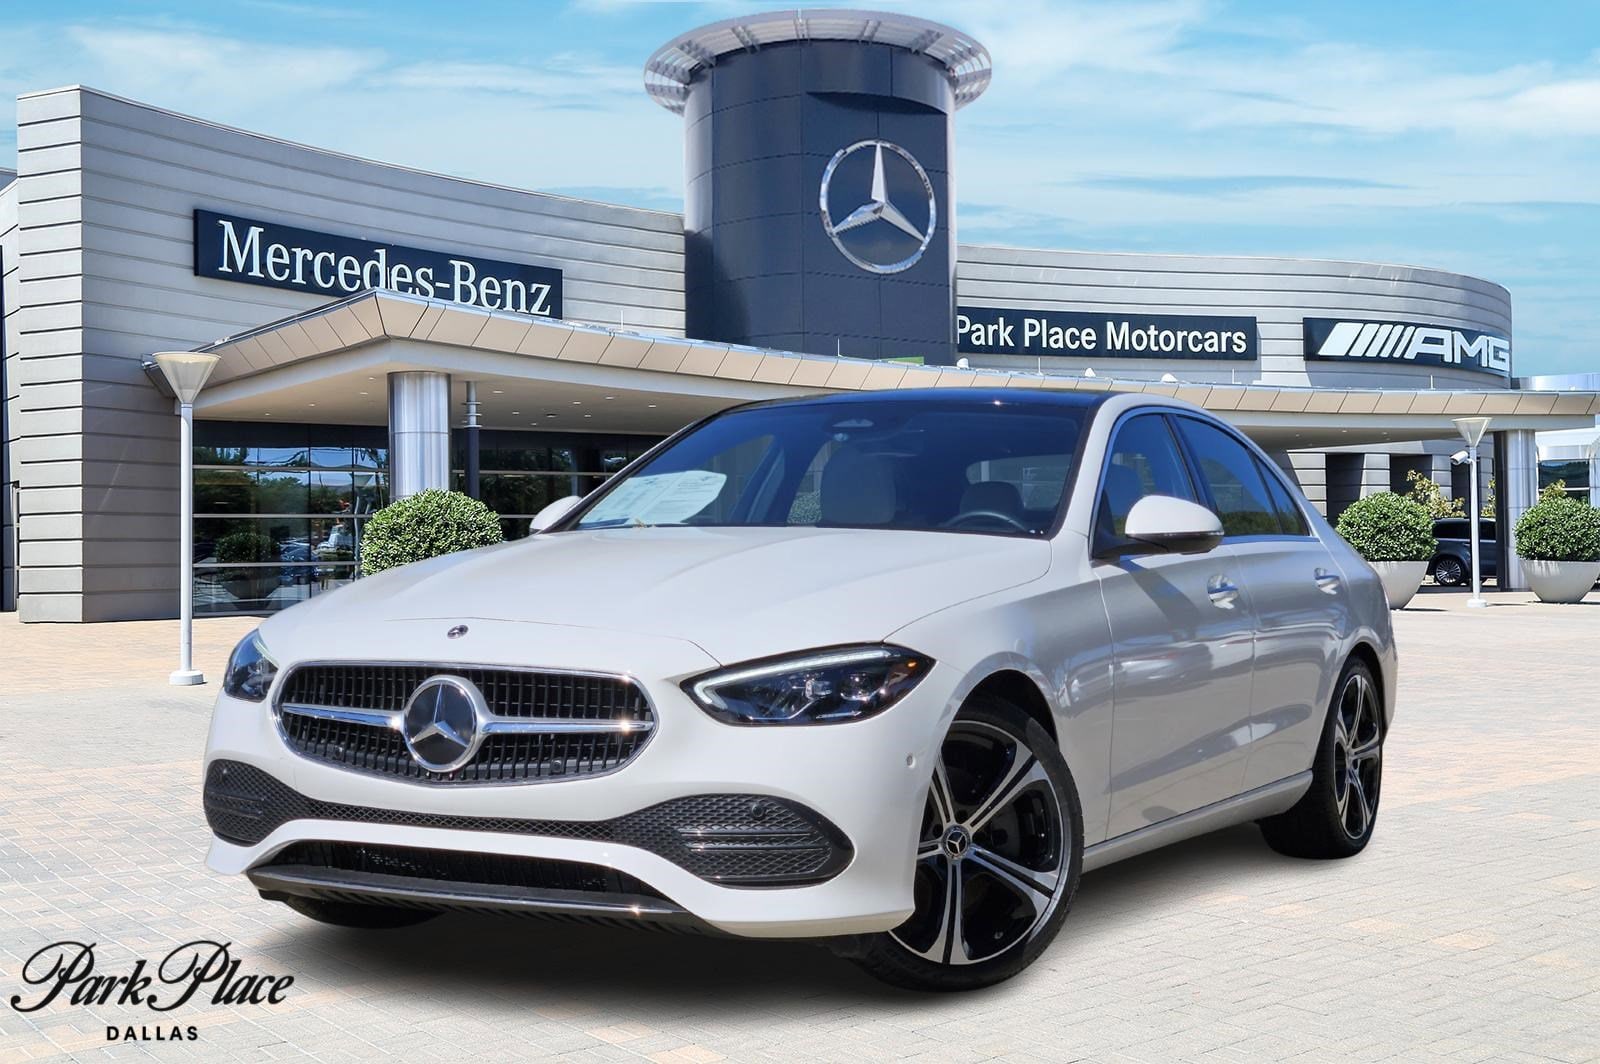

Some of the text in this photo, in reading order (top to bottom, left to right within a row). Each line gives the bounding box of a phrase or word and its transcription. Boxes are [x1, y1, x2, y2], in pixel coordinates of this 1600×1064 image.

[218, 219, 552, 317] Mercedes-Benz
[957, 315, 1248, 353] Park Place Motorcars
[1403, 326, 1510, 372] AMG
